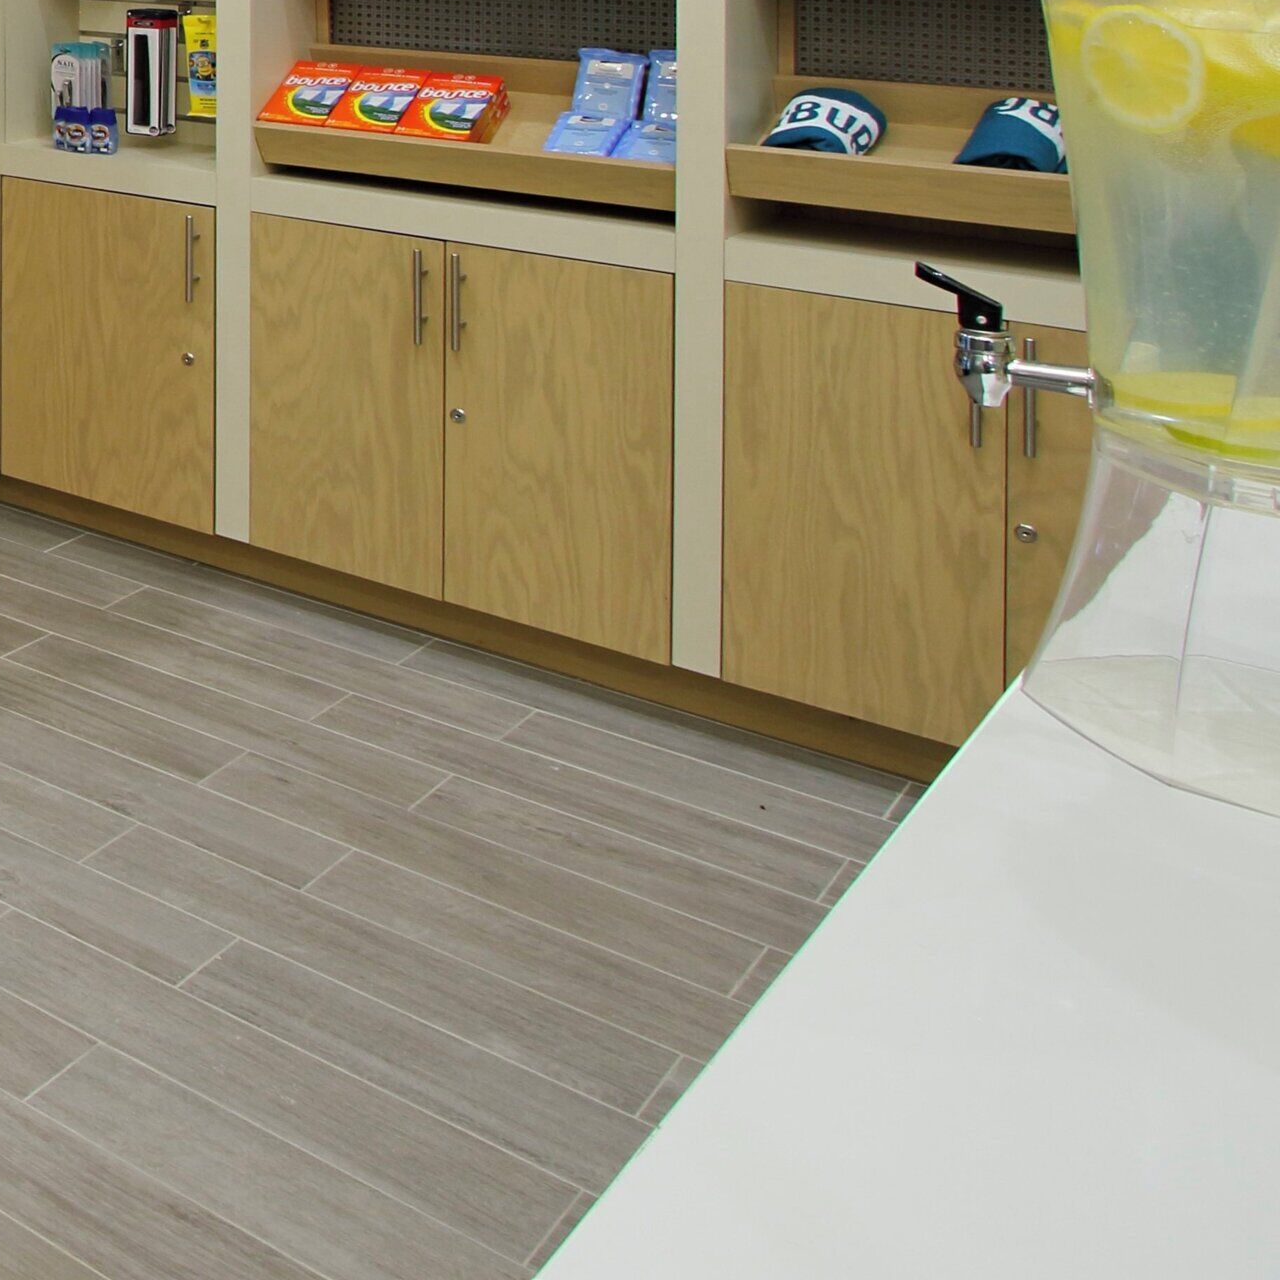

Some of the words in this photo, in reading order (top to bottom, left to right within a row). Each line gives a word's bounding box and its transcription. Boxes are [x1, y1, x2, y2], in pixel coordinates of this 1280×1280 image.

[285, 75, 347, 87] bounce
[351, 81, 416, 92] bounce
[419, 87, 488, 99] bounce
